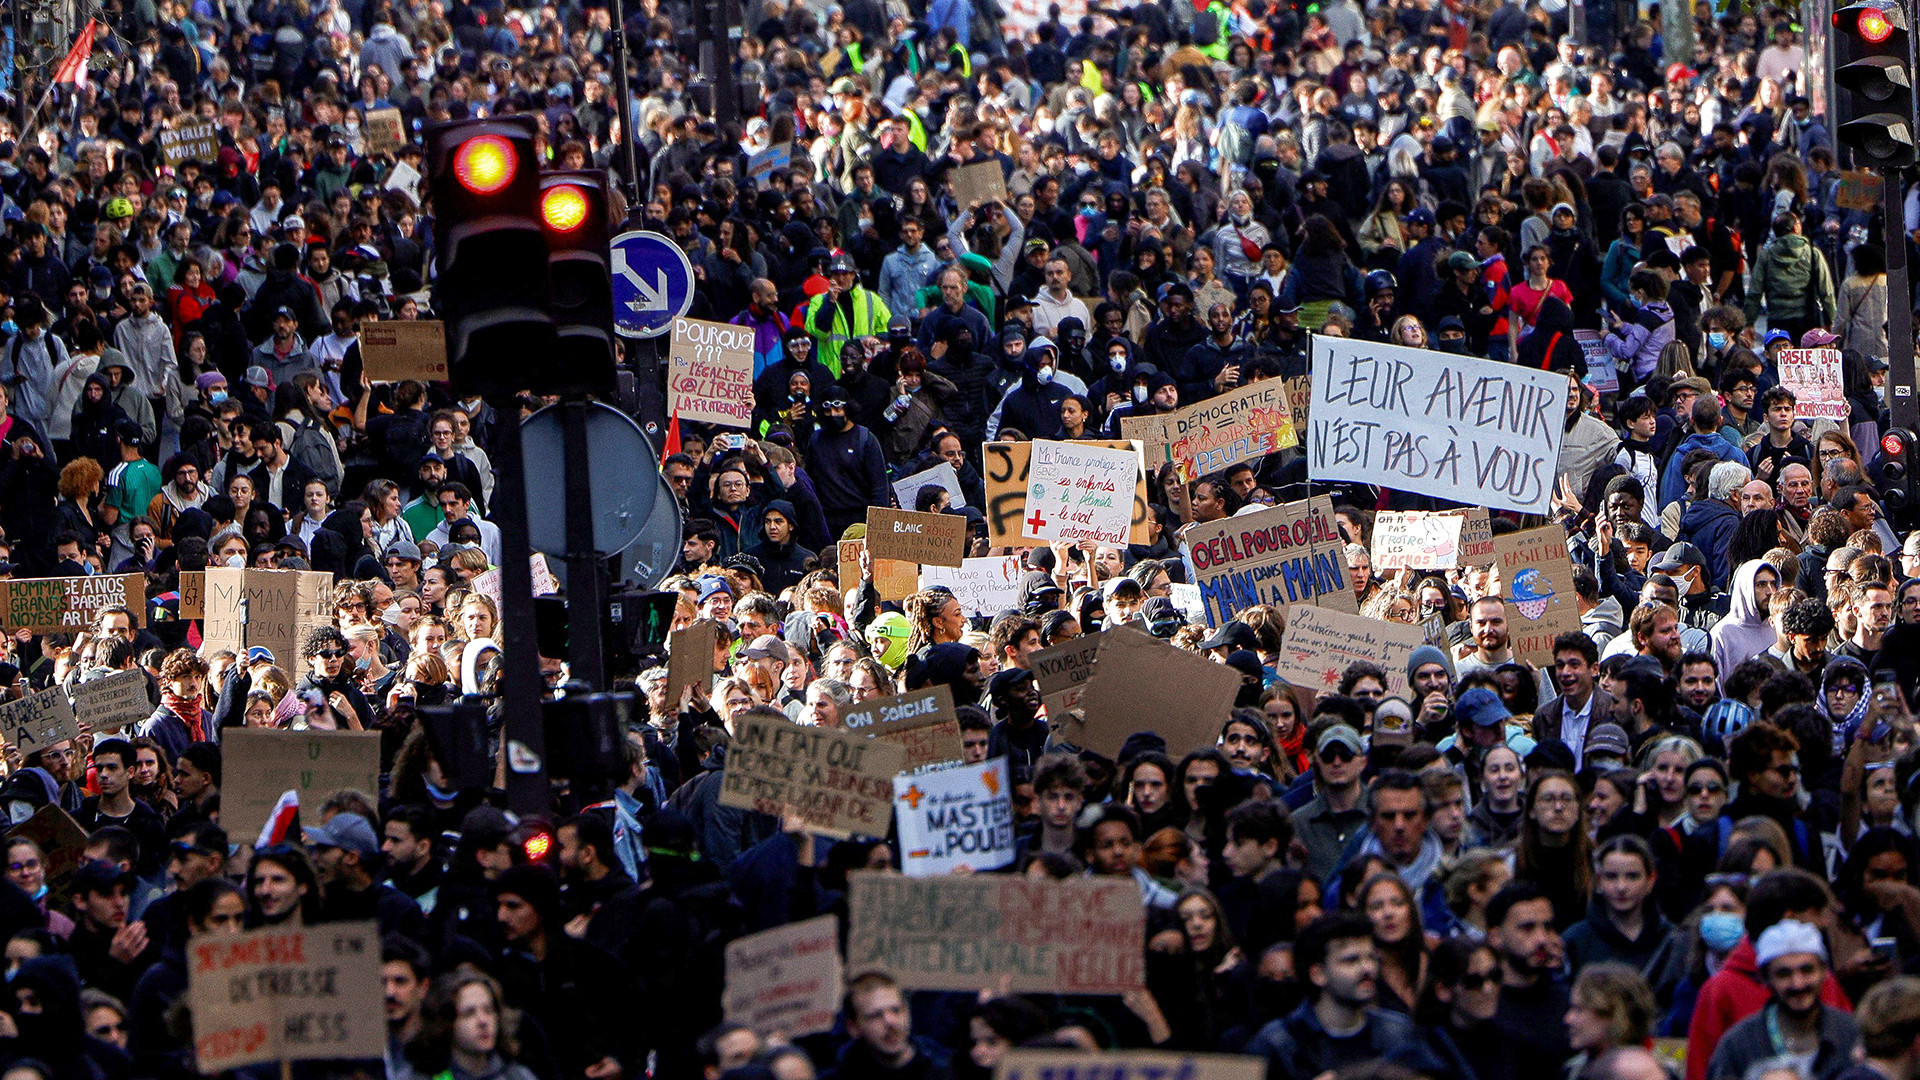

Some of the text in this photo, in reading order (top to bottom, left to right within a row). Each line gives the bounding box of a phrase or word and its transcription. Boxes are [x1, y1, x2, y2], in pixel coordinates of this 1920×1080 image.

[166, 143, 196, 159] VOUS
[675, 319, 755, 353] POURQUOI
[694, 344, 722, 363] ???
[1821, 350, 1839, 364] BOL
[1325, 349, 1555, 451] LEUR AVENIR
[1177, 388, 1276, 434] DÉMOCRATIE
[1177, 425, 1244, 458] POUVOIR
[1055, 447, 1082, 467] France
[1195, 432, 1273, 475] PEUPLE
[1383, 431, 1430, 478] PAS
[1434, 425, 1461, 485] À
[1472, 440, 1545, 505] VOUS
[1075, 475, 1115, 495] enfants
[1057, 505, 1094, 525] le droit
[894, 521, 923, 533] BLANC
[926, 526, 956, 538] ROUGE
[1060, 525, 1127, 545] international
[1192, 507, 1338, 570] OEIL POUR OEIL
[1388, 525, 1407, 533] PAS
[927, 538, 953, 549] NOIR
[1379, 534, 1424, 546] TROTRO
[1379, 554, 1431, 566] FACHOS
[186, 574, 196, 587] LA
[951, 567, 978, 580] Have
[9, 579, 79, 596] HOMMAGE
[95, 577, 125, 594] NOS
[185, 588, 198, 605] 67
[1198, 550, 1344, 628] MAIN DANS LA MAIN
[10, 595, 68, 612] GRANDS
[214, 583, 296, 613] MAMAN
[56, 611, 81, 626] PAR
[250, 620, 286, 639] PEUR
[1038, 647, 1098, 678] N'OUBLIEZ
[845, 696, 939, 729] ON SOIGNE
[735, 719, 770, 745] UN
[827, 739, 867, 771] QUI
